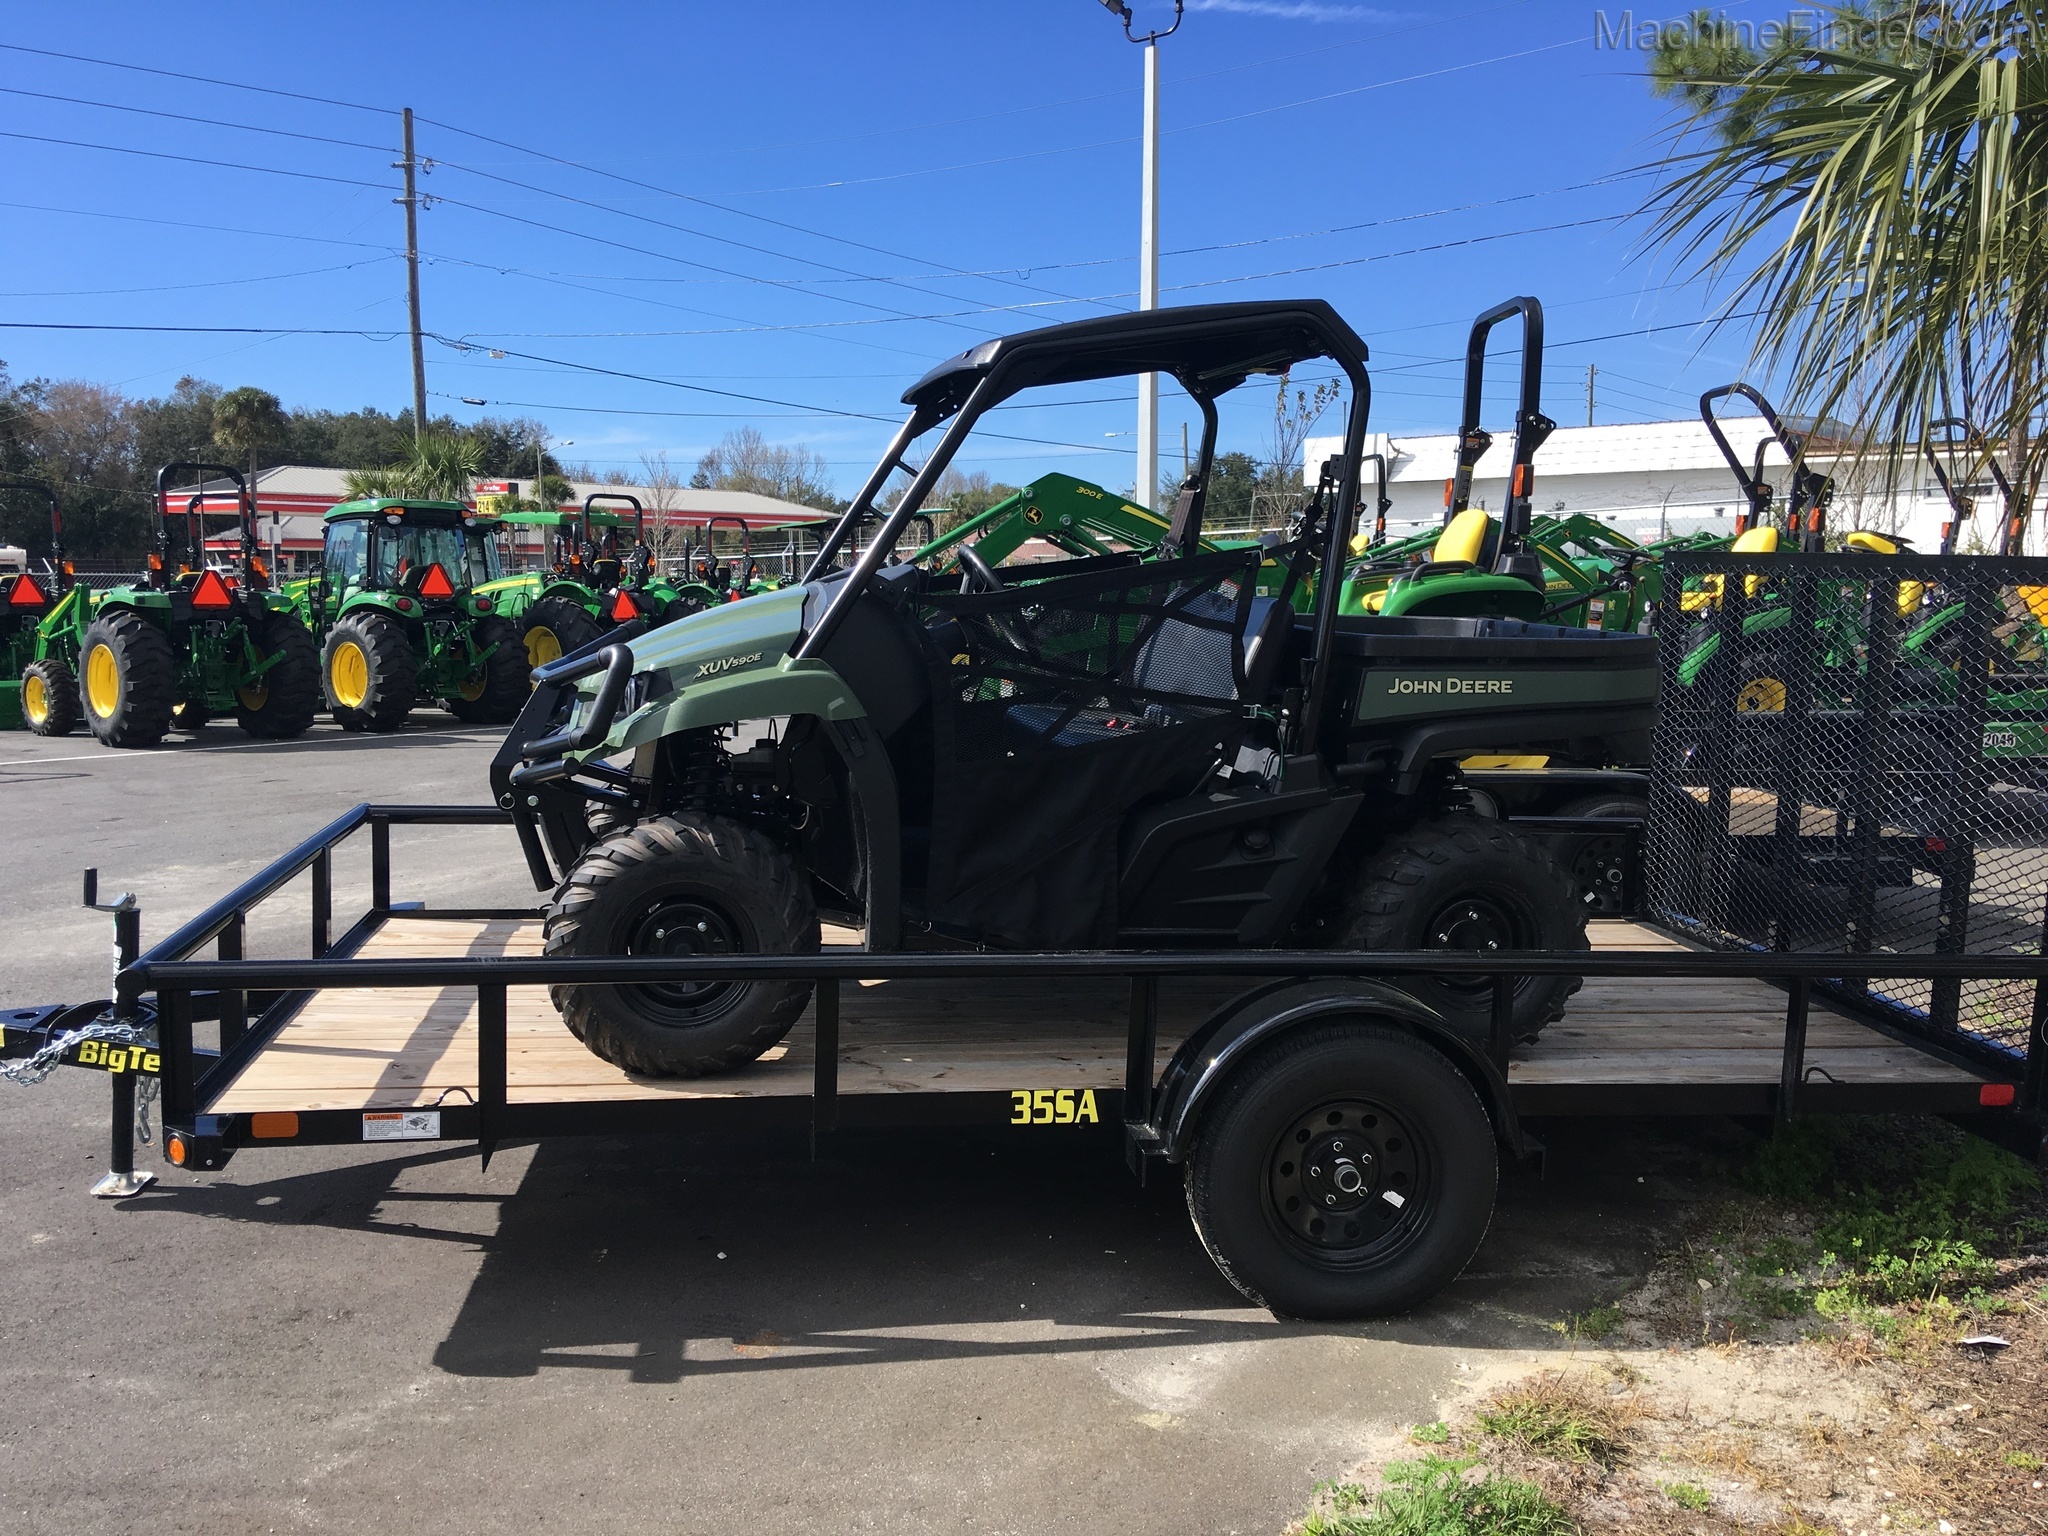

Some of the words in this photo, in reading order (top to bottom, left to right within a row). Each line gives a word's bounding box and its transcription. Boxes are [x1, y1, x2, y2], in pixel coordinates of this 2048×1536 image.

[693, 652, 763, 680] XUV590E
[1387, 677, 1442, 694] JOHN
[1446, 677, 1513, 694] DEERE
[78, 1040, 161, 1074] BigTe
[1010, 1089, 1100, 1125] 35SA
